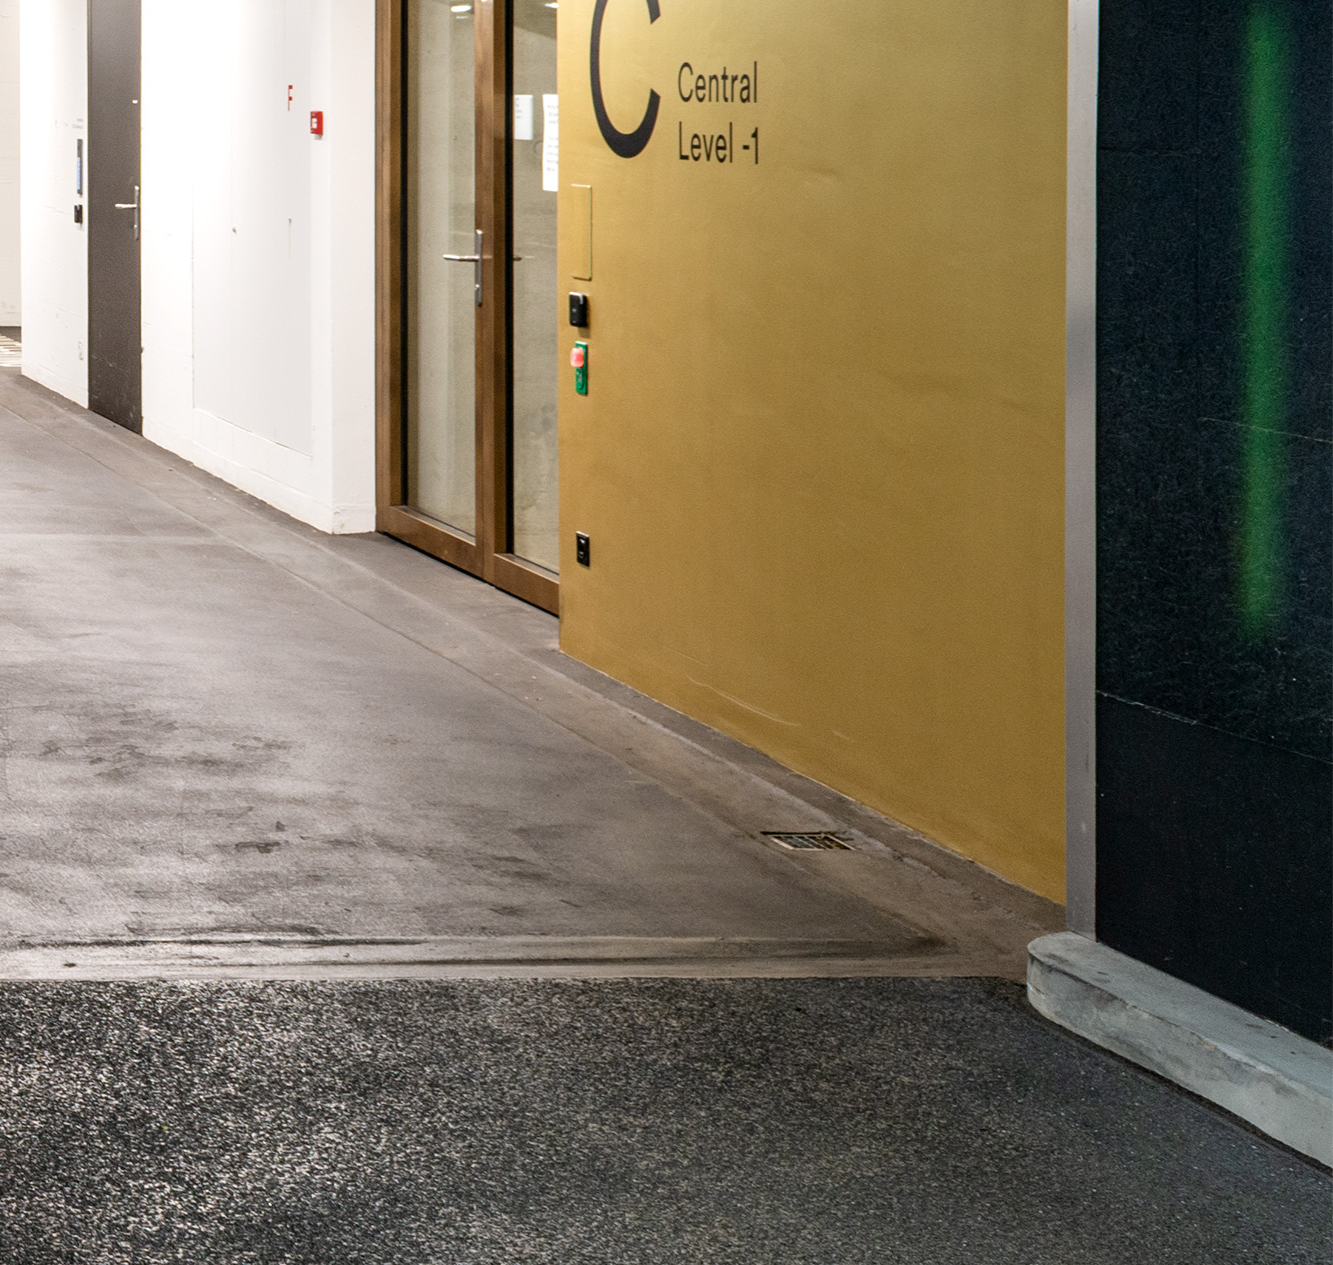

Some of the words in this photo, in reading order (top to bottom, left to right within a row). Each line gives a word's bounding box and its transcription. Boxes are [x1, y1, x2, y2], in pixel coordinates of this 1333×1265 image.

[678, 61, 757, 103] Central
[679, 122, 733, 163] Level
[743, 127, 758, 164] -1
